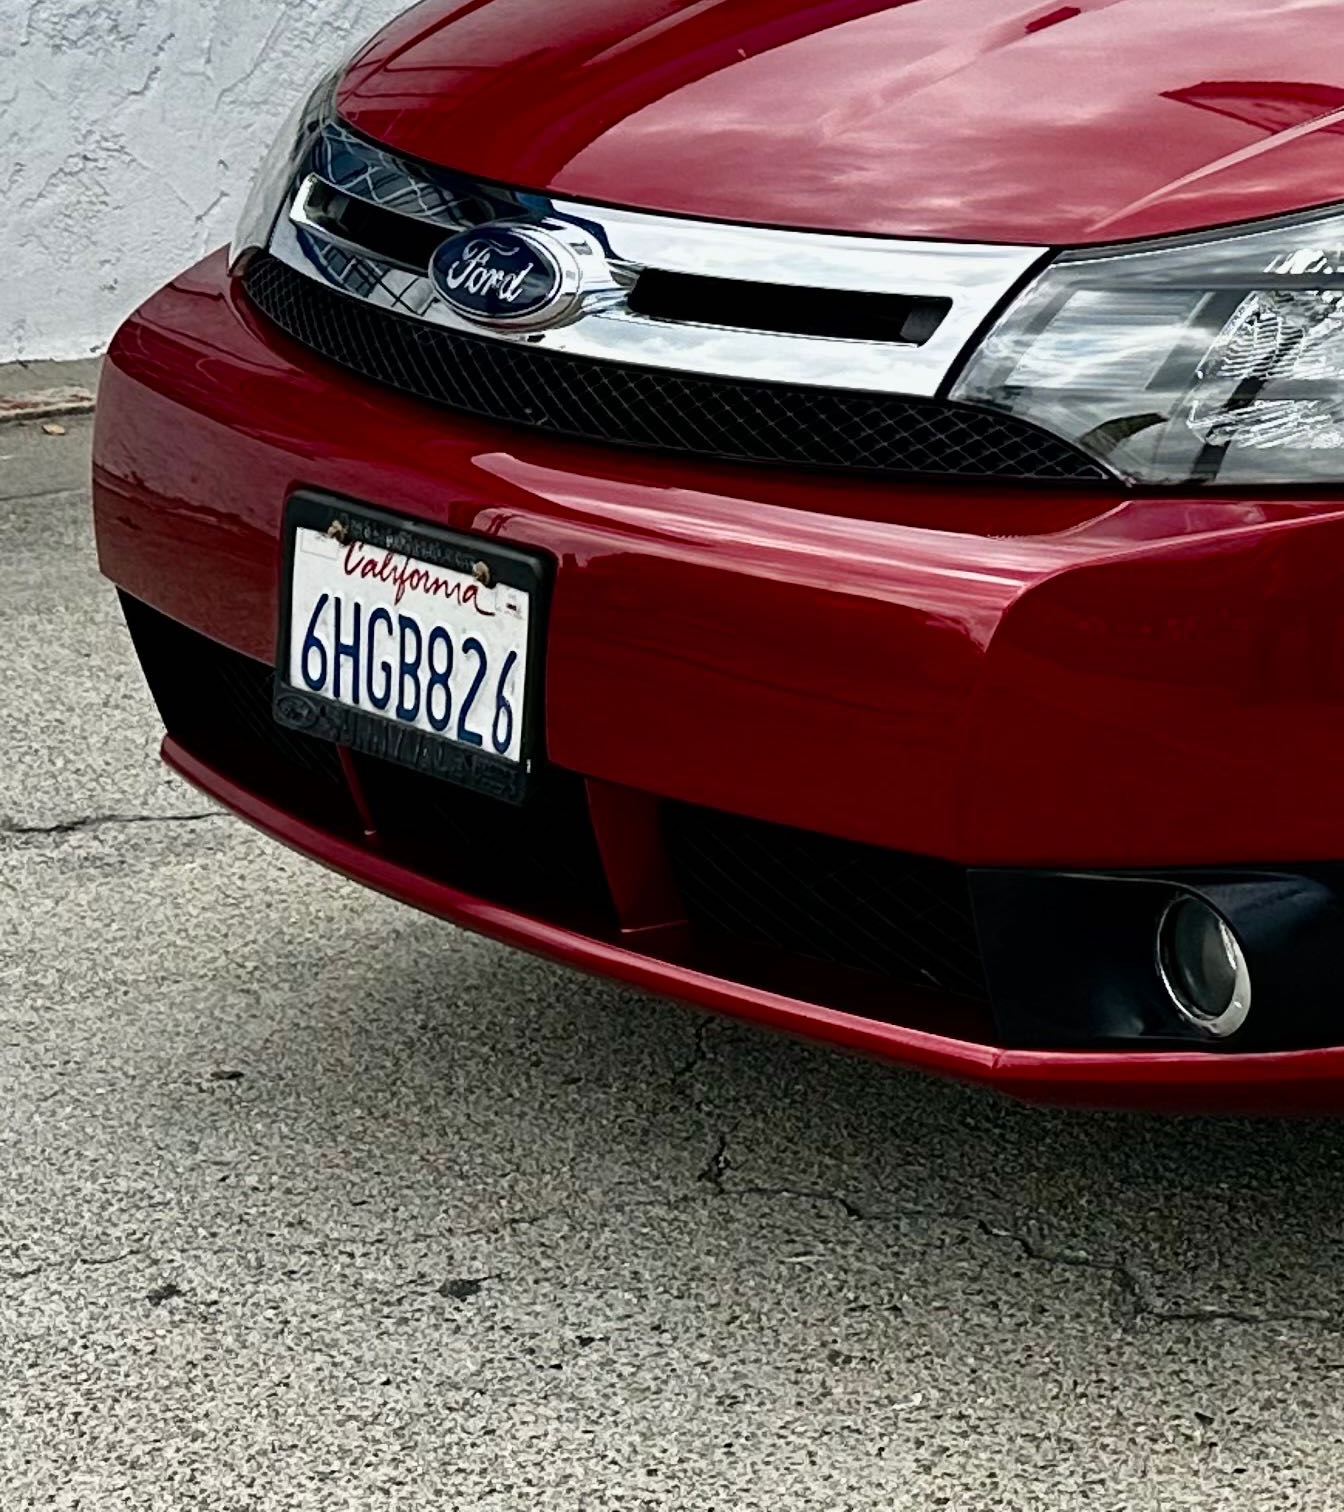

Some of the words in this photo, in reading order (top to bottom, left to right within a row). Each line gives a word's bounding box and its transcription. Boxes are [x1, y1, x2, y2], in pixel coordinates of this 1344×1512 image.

[447, 239, 534, 302] Ford
[344, 541, 496, 615] California
[301, 593, 518, 755] 6HGB826
